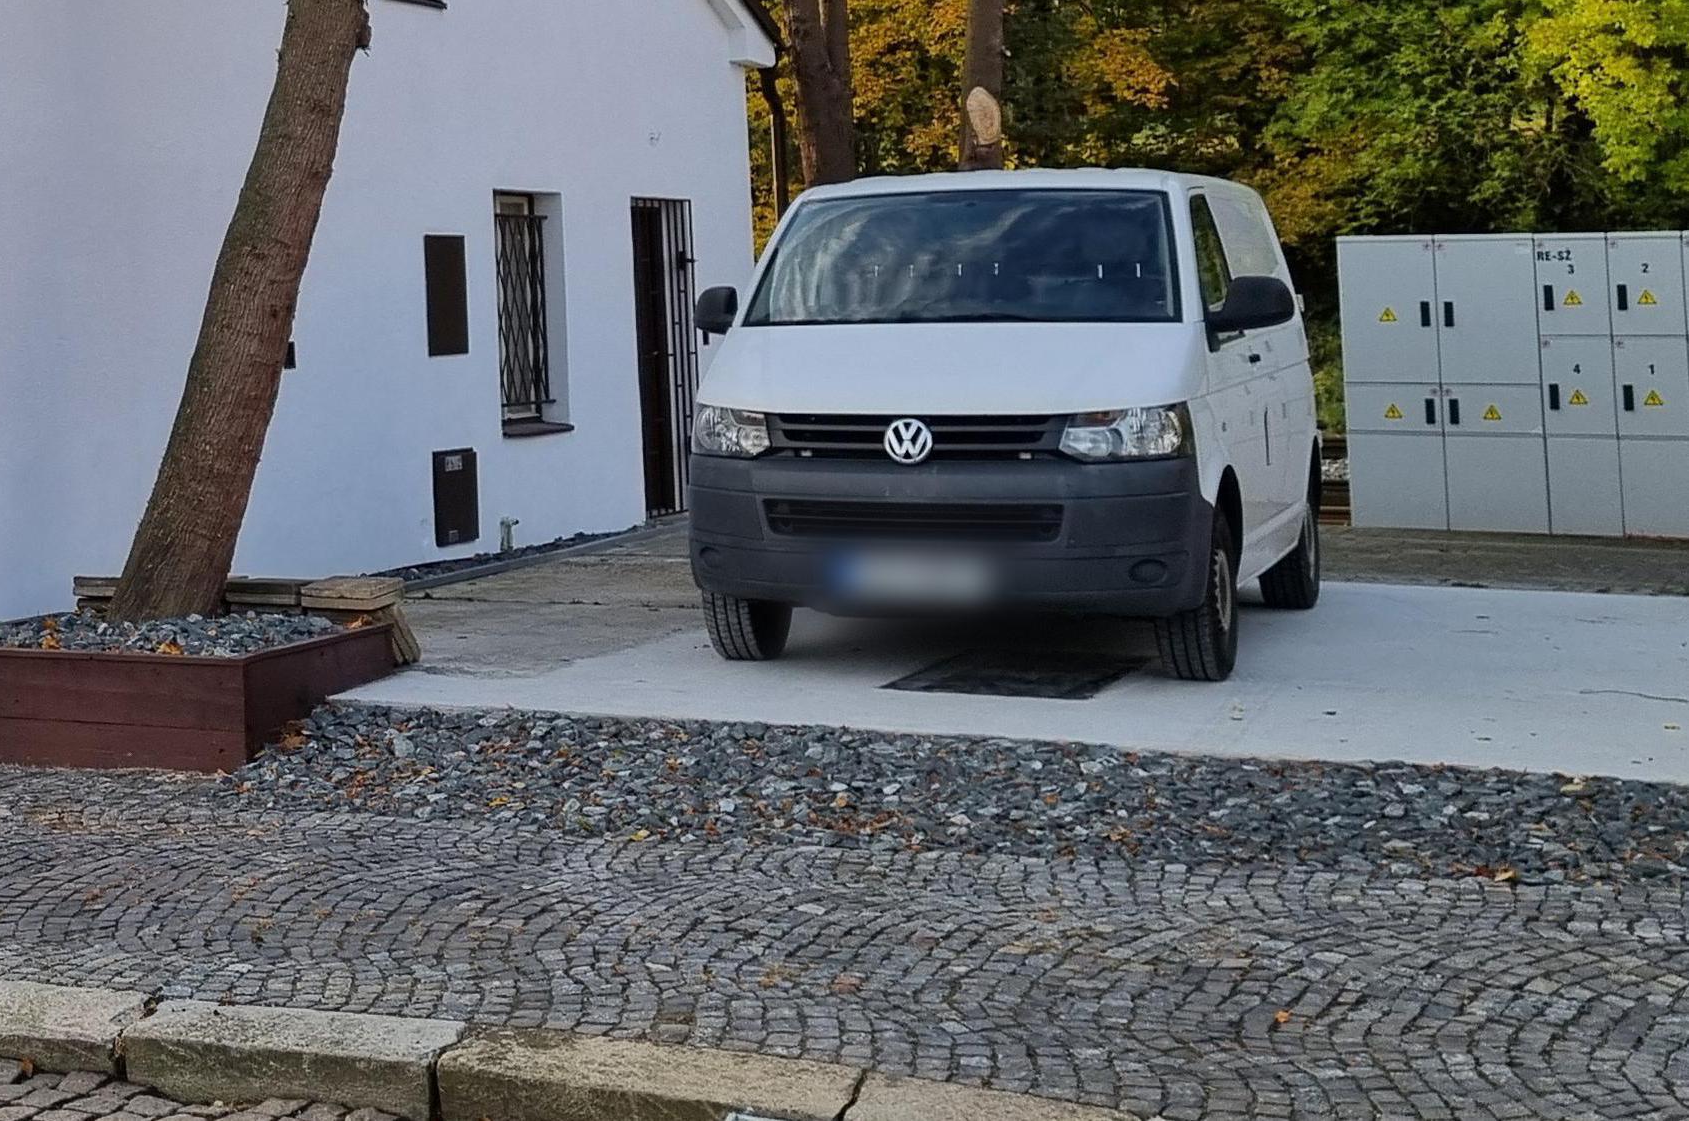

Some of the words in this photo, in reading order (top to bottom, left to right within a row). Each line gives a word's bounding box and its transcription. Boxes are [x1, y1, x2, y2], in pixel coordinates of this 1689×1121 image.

[1567, 264, 1575, 275] 3
[1641, 262, 1649, 274] 2
[1573, 363, 1581, 374] 4
[1648, 363, 1655, 375] 1
[885, 418, 932, 464] VW
